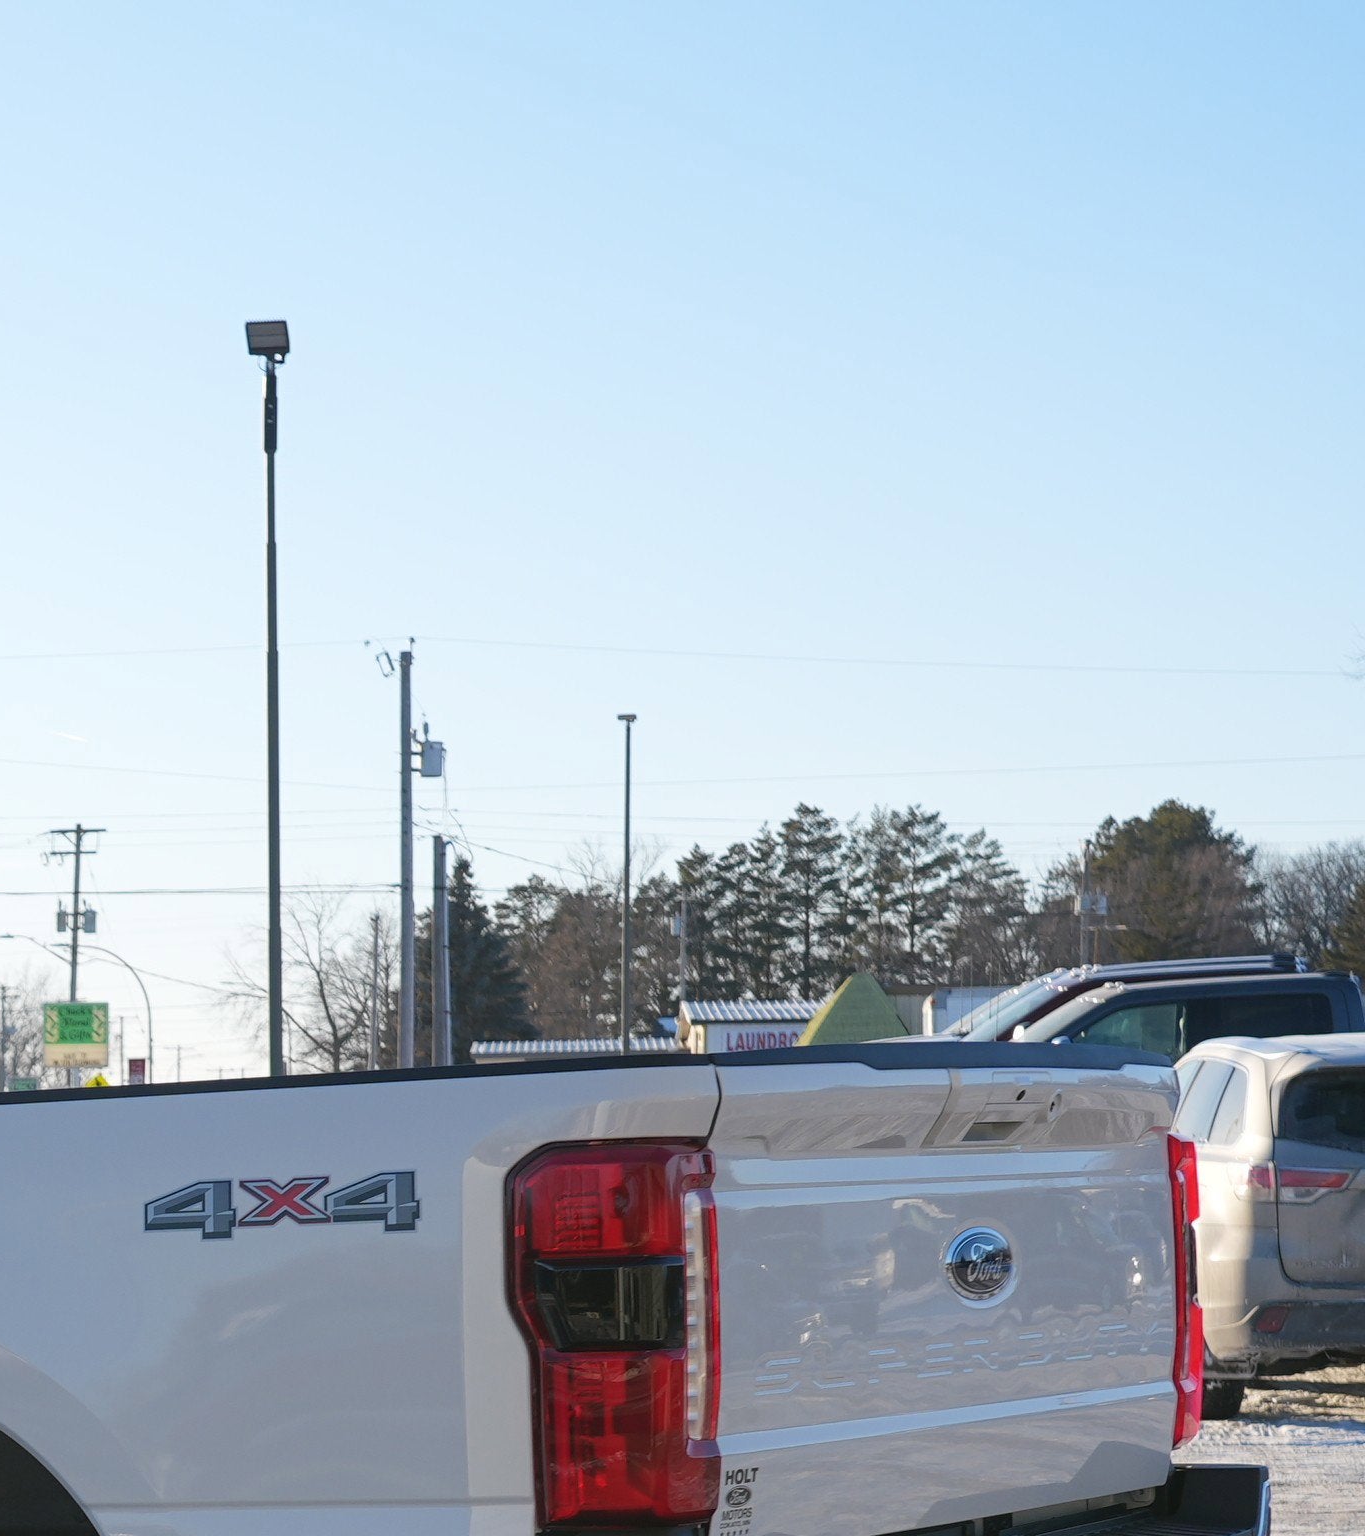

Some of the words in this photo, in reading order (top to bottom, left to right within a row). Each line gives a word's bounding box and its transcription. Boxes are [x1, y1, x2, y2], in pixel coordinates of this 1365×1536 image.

[726, 1031, 800, 1052] LAUNDRO
[967, 1242, 1004, 1282] Ford
[725, 1467, 759, 1485] HOLT
[721, 1507, 752, 1521] MOTORS
